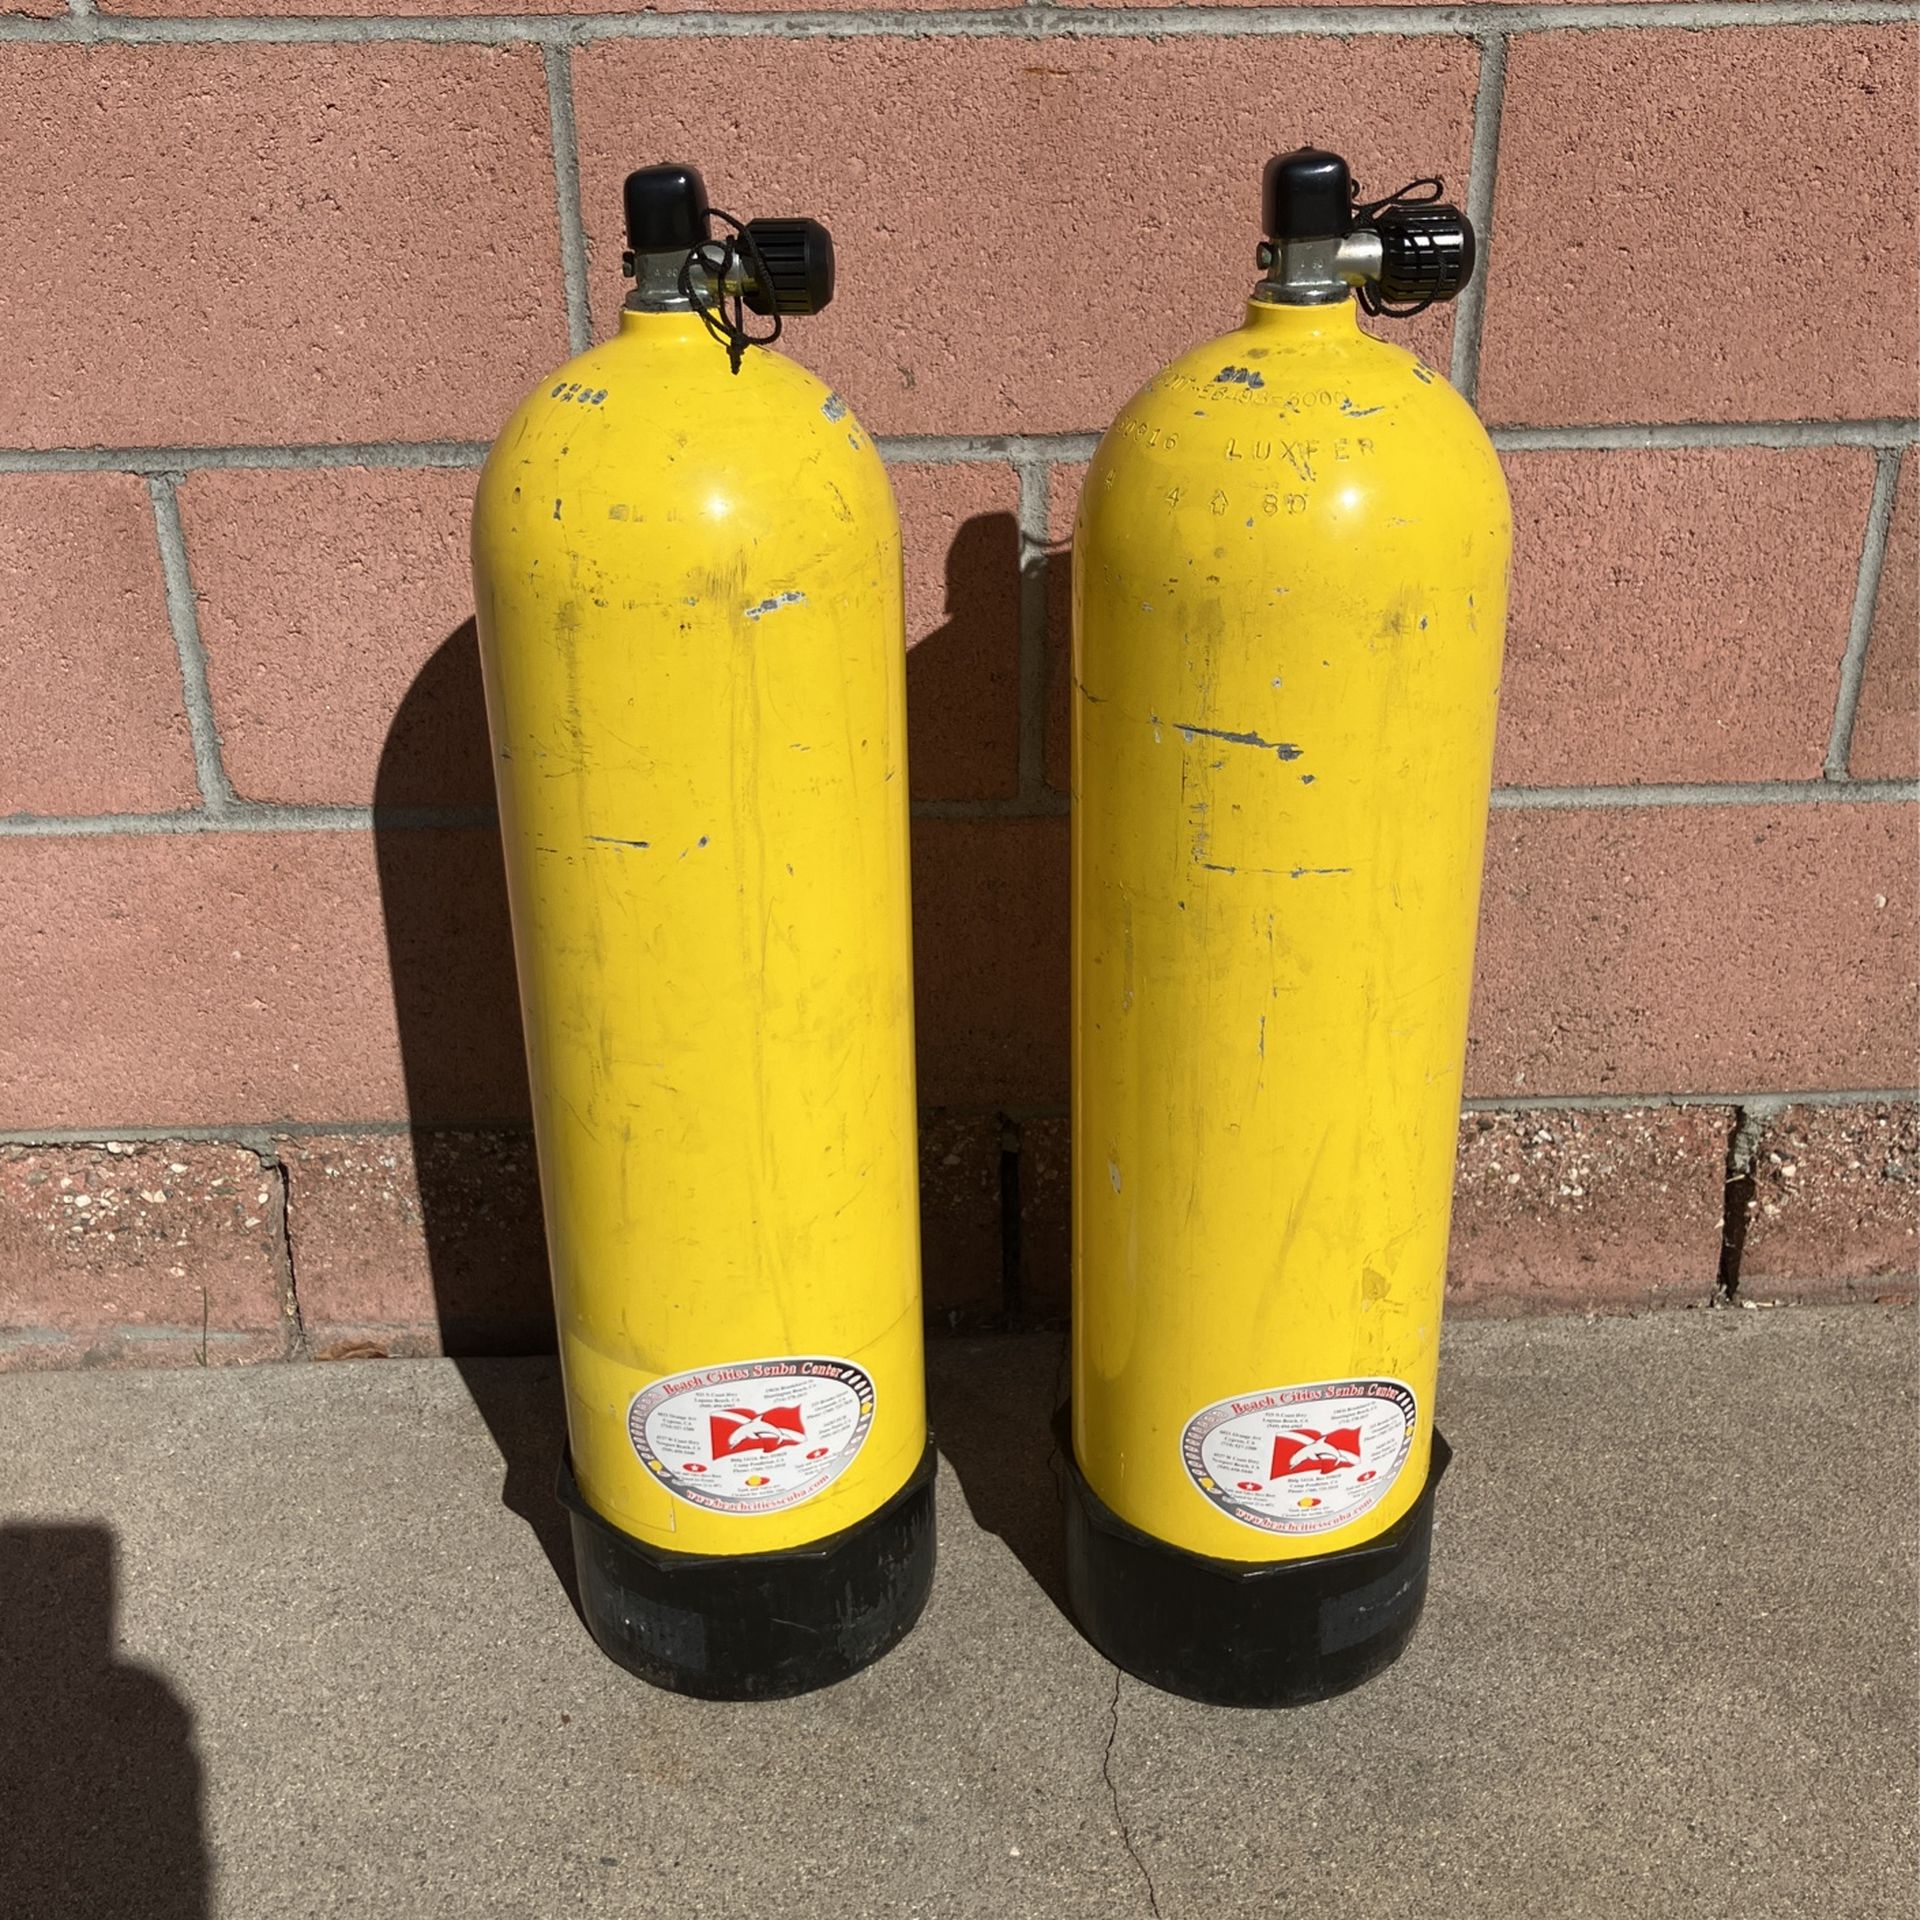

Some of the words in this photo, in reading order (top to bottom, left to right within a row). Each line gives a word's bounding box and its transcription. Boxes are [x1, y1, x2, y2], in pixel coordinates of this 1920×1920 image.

[1225, 437, 1375, 461] LUXFER
[662, 1375, 703, 1396] Beach
[707, 1368, 750, 1386] Cities
[752, 1364, 797, 1377] Scuba
[800, 1361, 843, 1378] Center
[1231, 1395, 1275, 1414] Beach
[1279, 1389, 1322, 1405] Cities
[1325, 1384, 1364, 1398] Scuba
[1367, 1383, 1398, 1400] Center
